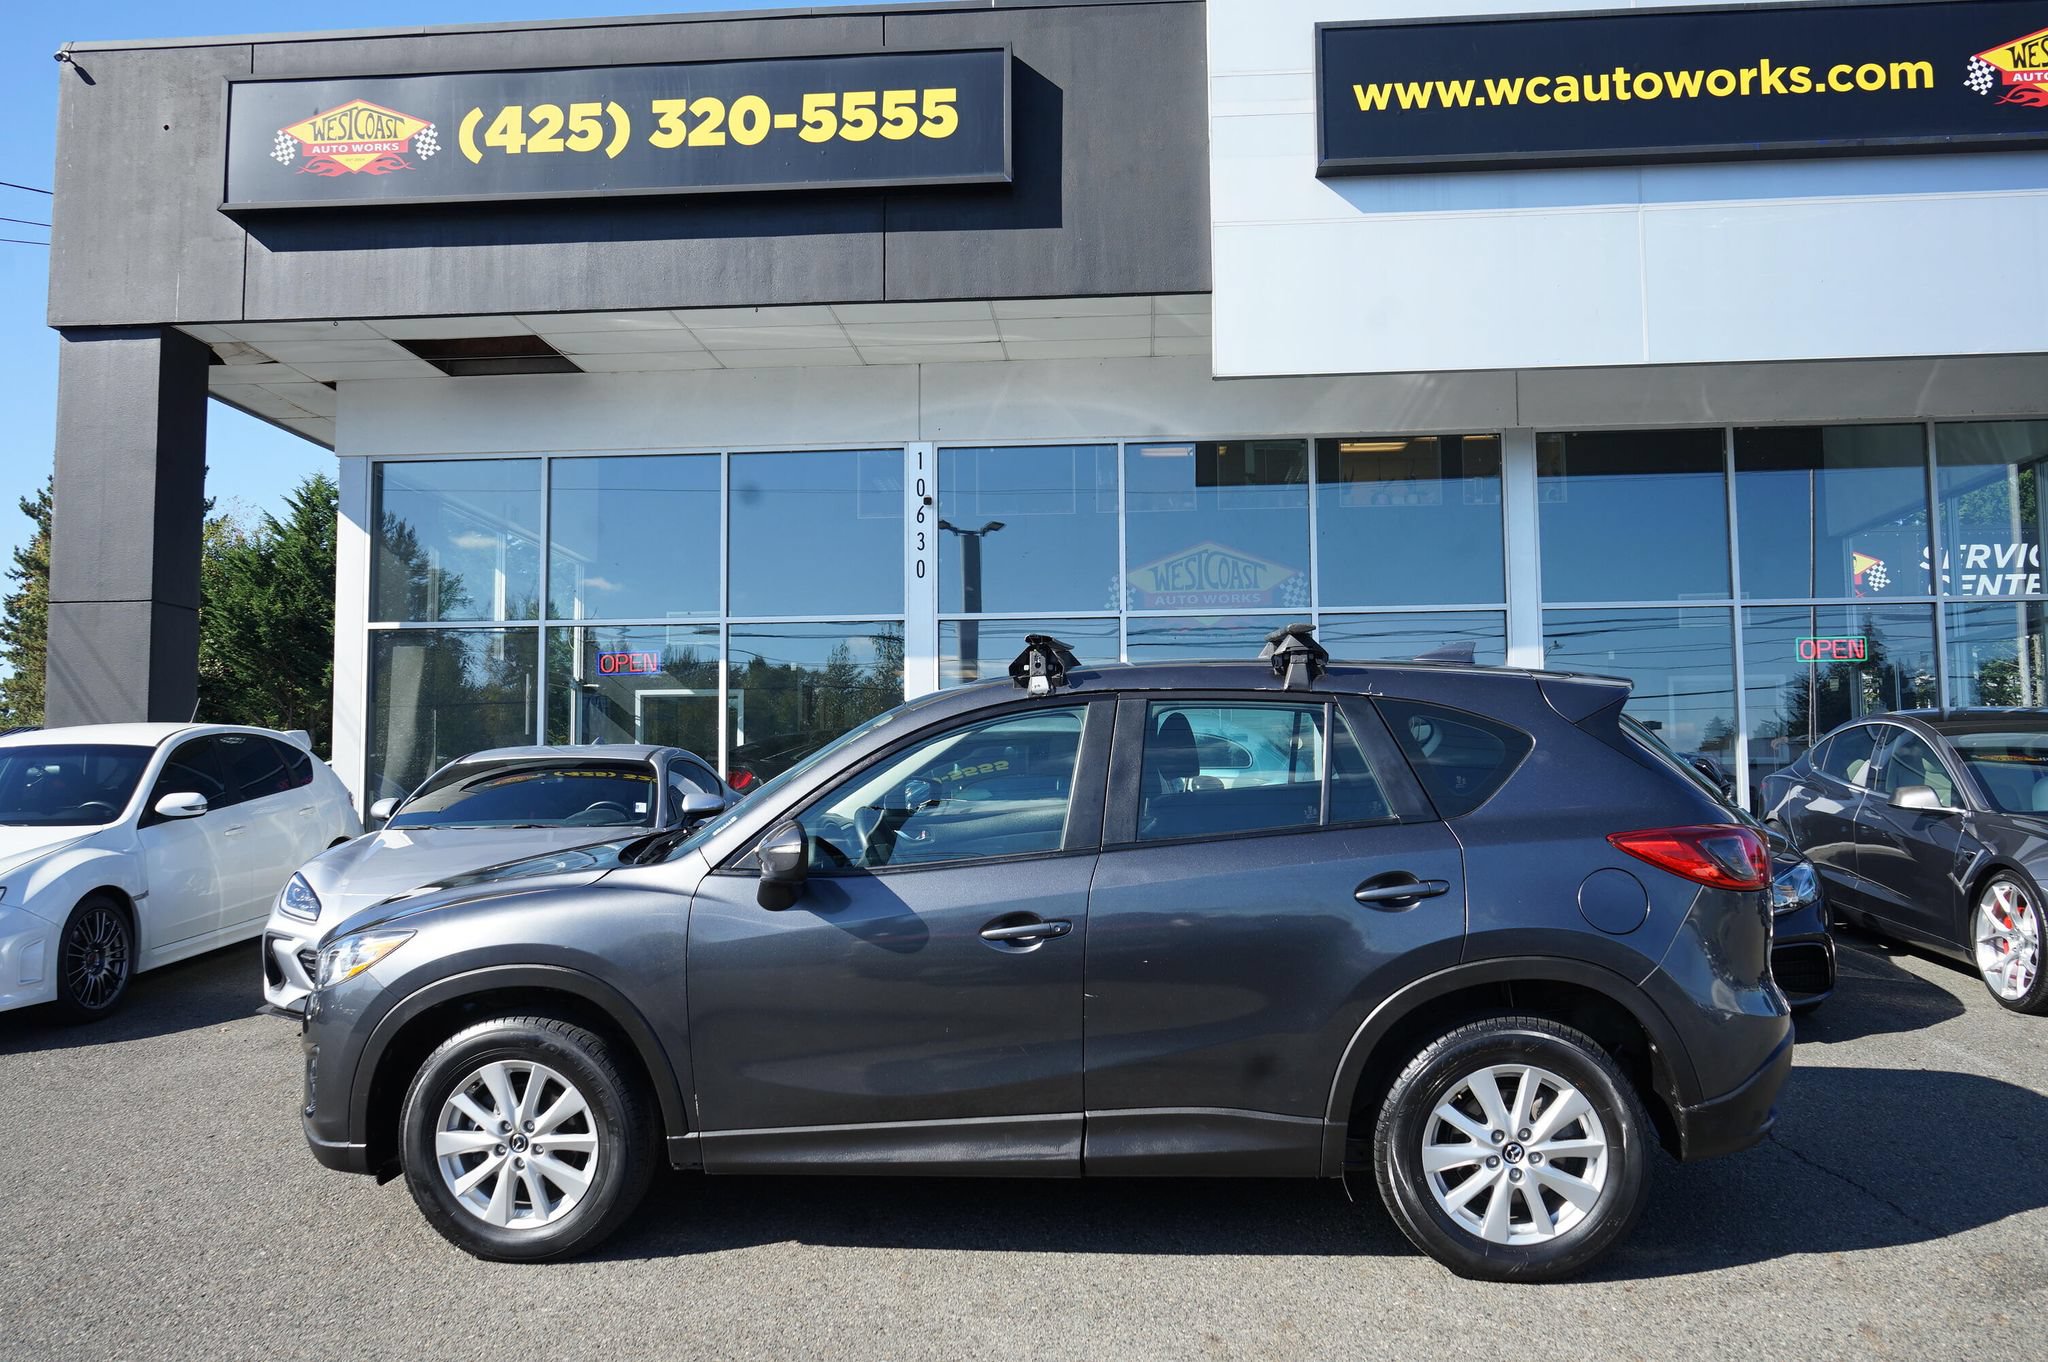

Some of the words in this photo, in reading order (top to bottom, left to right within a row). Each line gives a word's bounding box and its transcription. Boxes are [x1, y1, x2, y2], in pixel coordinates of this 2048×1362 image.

[1353, 58, 1935, 112] www.wcautoworks.com
[458, 100, 631, 165] (425)
[648, 87, 958, 149] 320-5555
[312, 144, 349, 155] AUTO
[351, 142, 400, 153] WORKS
[1154, 595, 1199, 606] AUTO
[1203, 593, 1261, 605] WORKS
[1800, 639, 1865, 660] OPEN
[600, 652, 657, 673] OPEN
